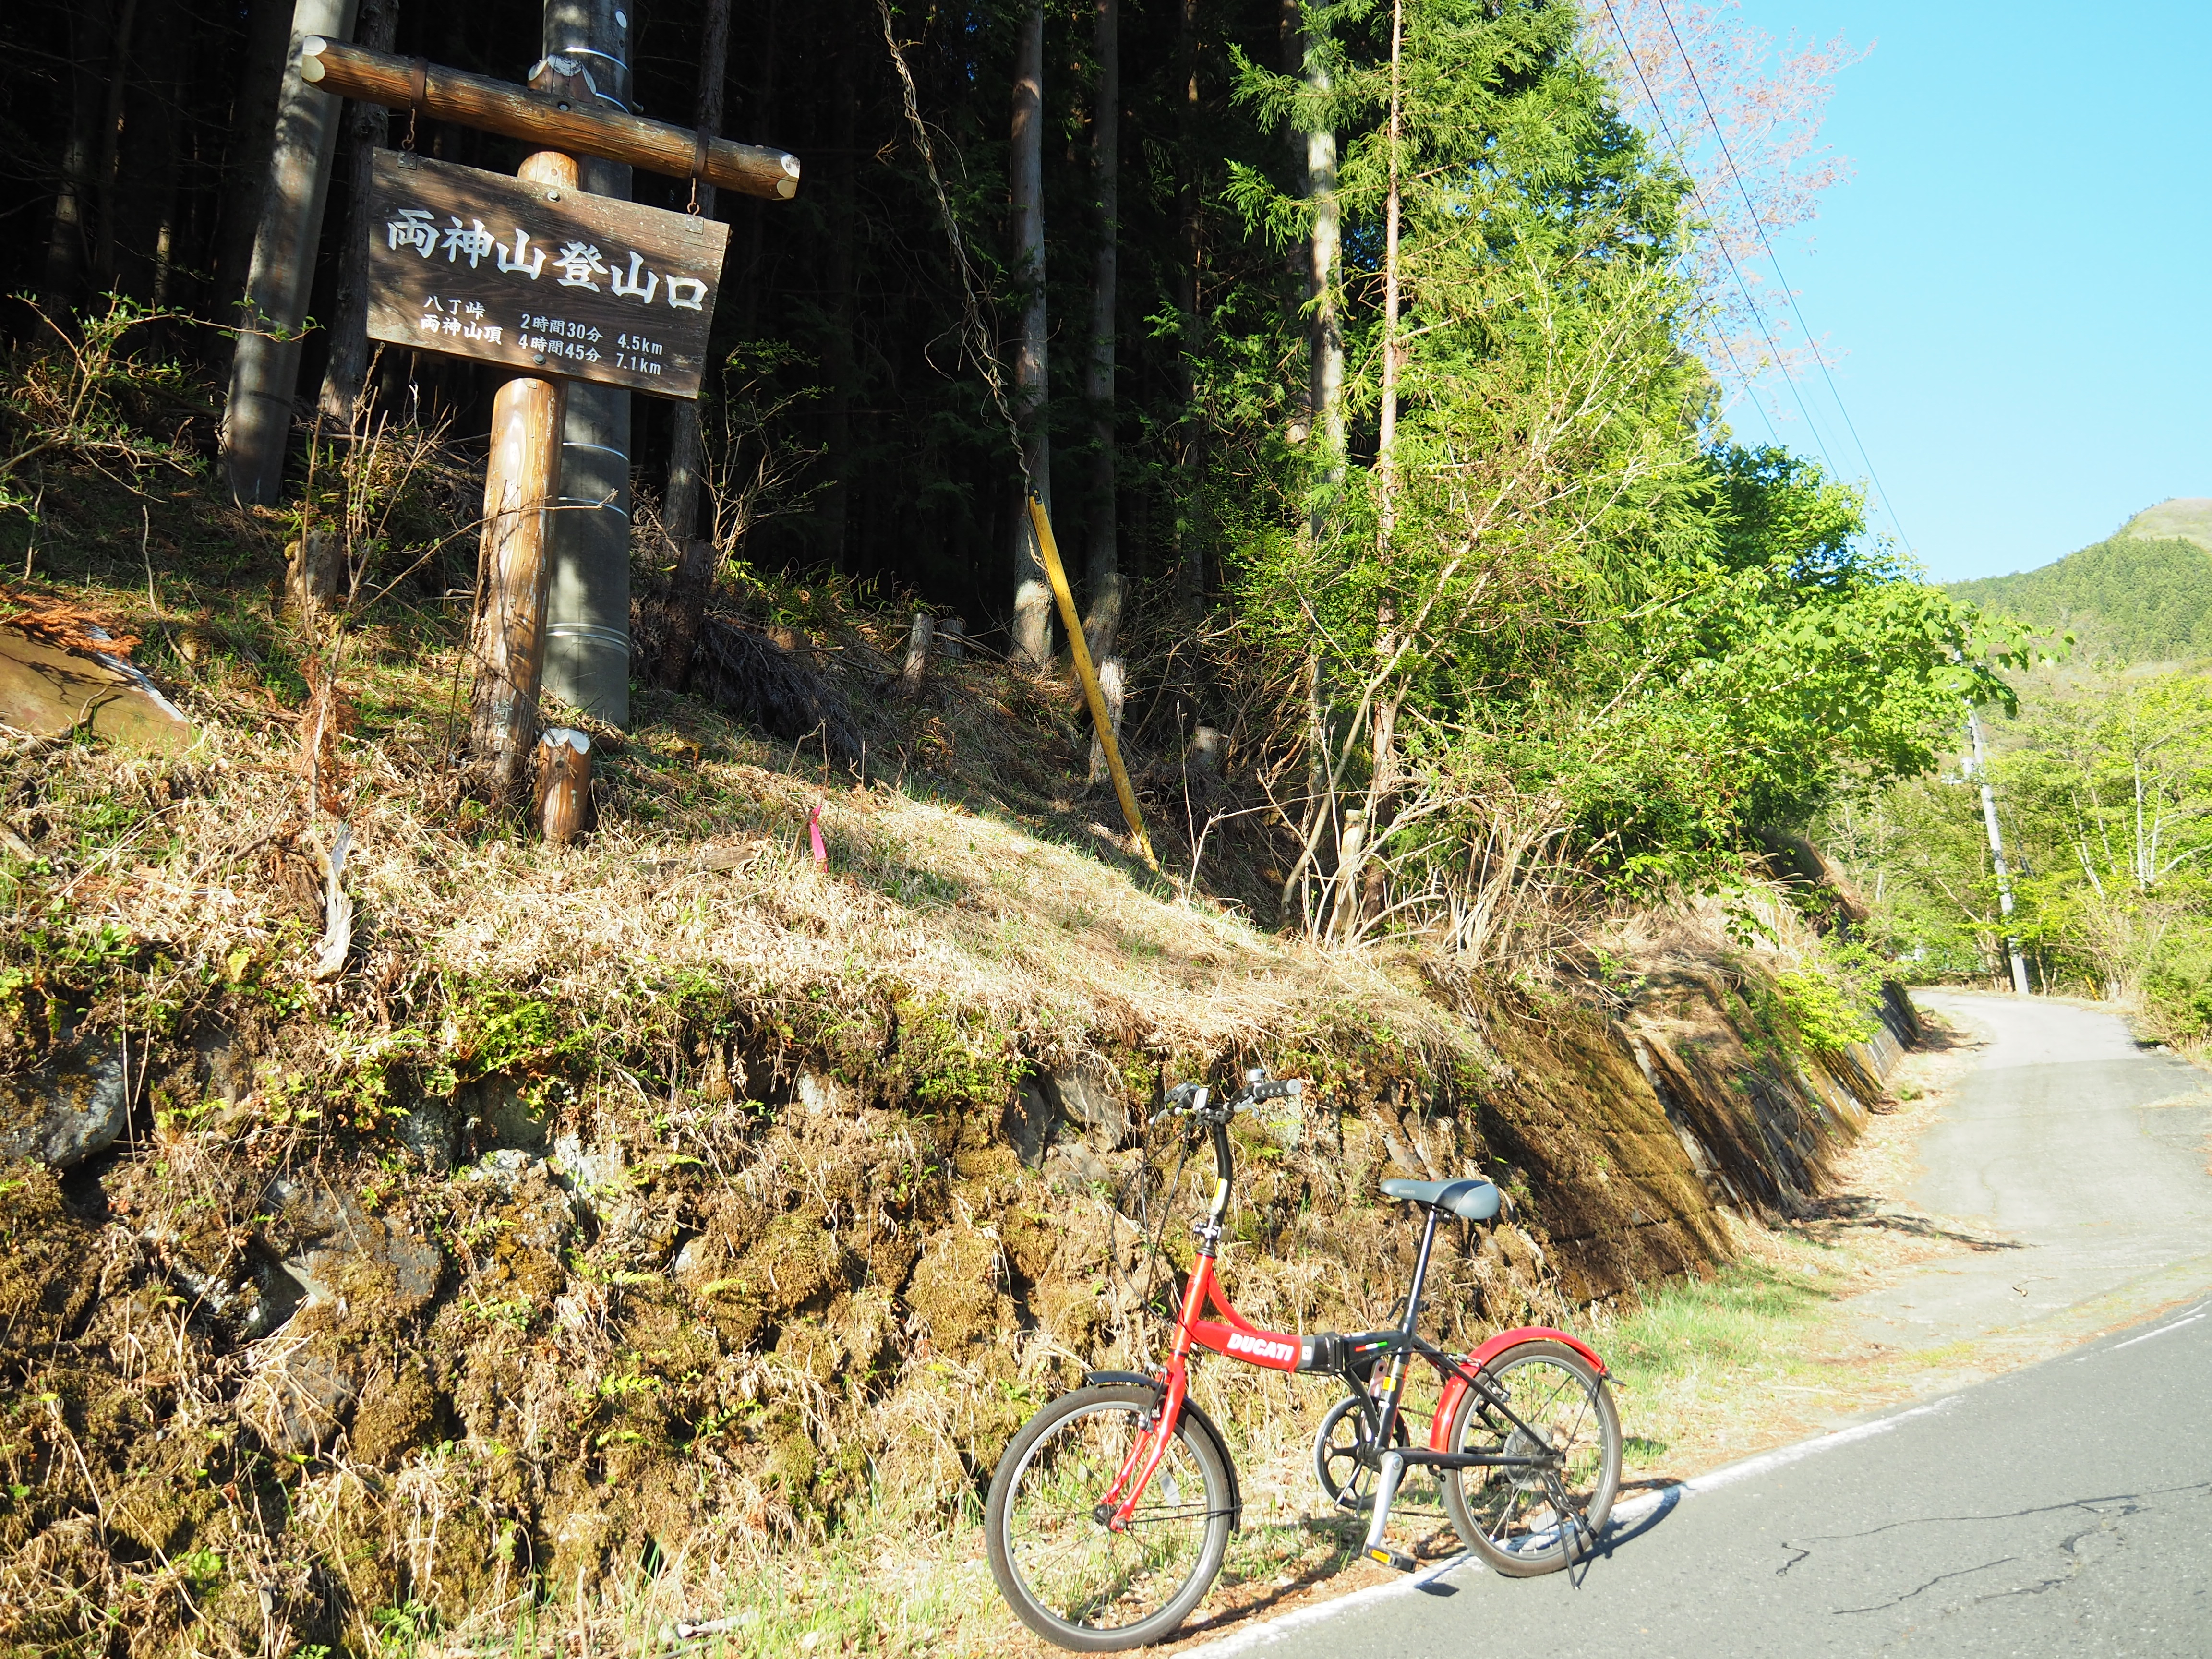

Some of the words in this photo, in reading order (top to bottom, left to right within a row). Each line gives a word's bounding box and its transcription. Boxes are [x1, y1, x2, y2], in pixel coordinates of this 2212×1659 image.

[387, 209, 708, 310] 両神山登山口
[421, 313, 504, 345] 両神山頂
[518, 334, 602, 363] 4時間45分
[616, 352, 661, 375] 7.1km
[423, 295, 486, 320] 八丁峠
[520, 313, 604, 343] 2時間30分
[617, 333, 663, 355] 4.5km
[1226, 1333, 1294, 1361] DUCATI
